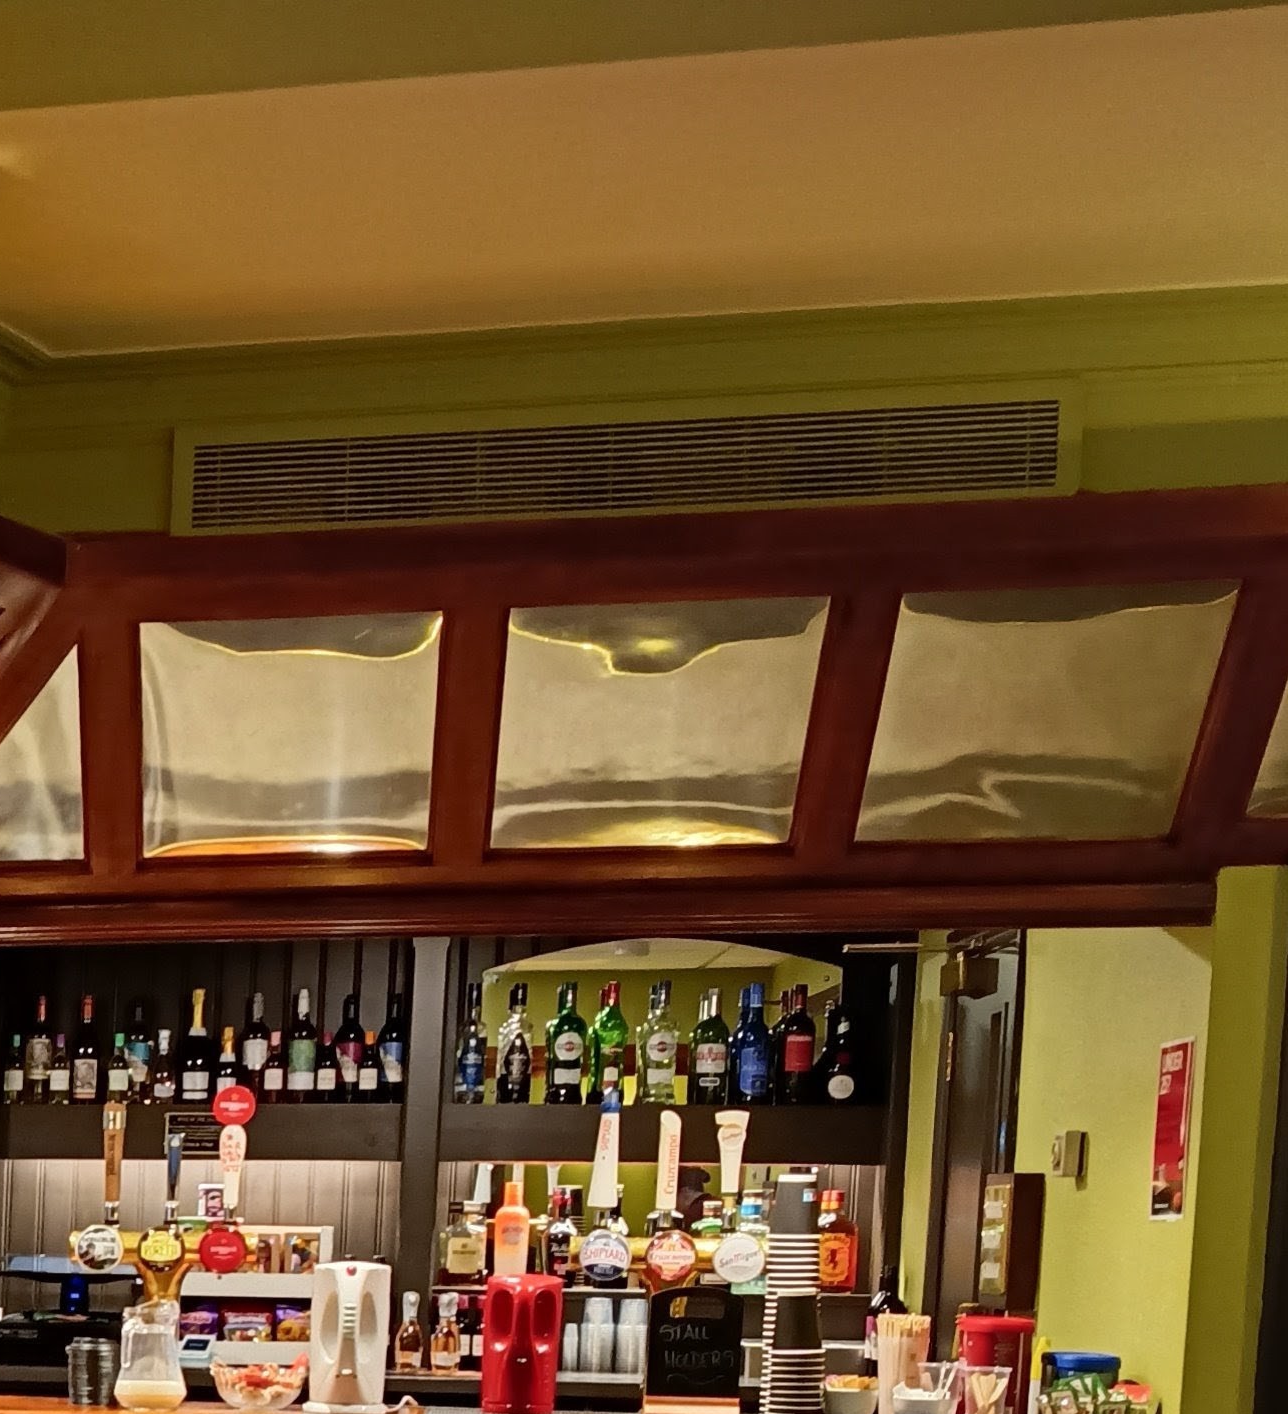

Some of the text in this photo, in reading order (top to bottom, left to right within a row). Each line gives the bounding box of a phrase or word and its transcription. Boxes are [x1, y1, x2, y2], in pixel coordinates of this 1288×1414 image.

[664, 1134, 680, 1195] Cruzcampo
[584, 1246, 626, 1262] SHIPYARD
[658, 1324, 710, 1342] STALL
